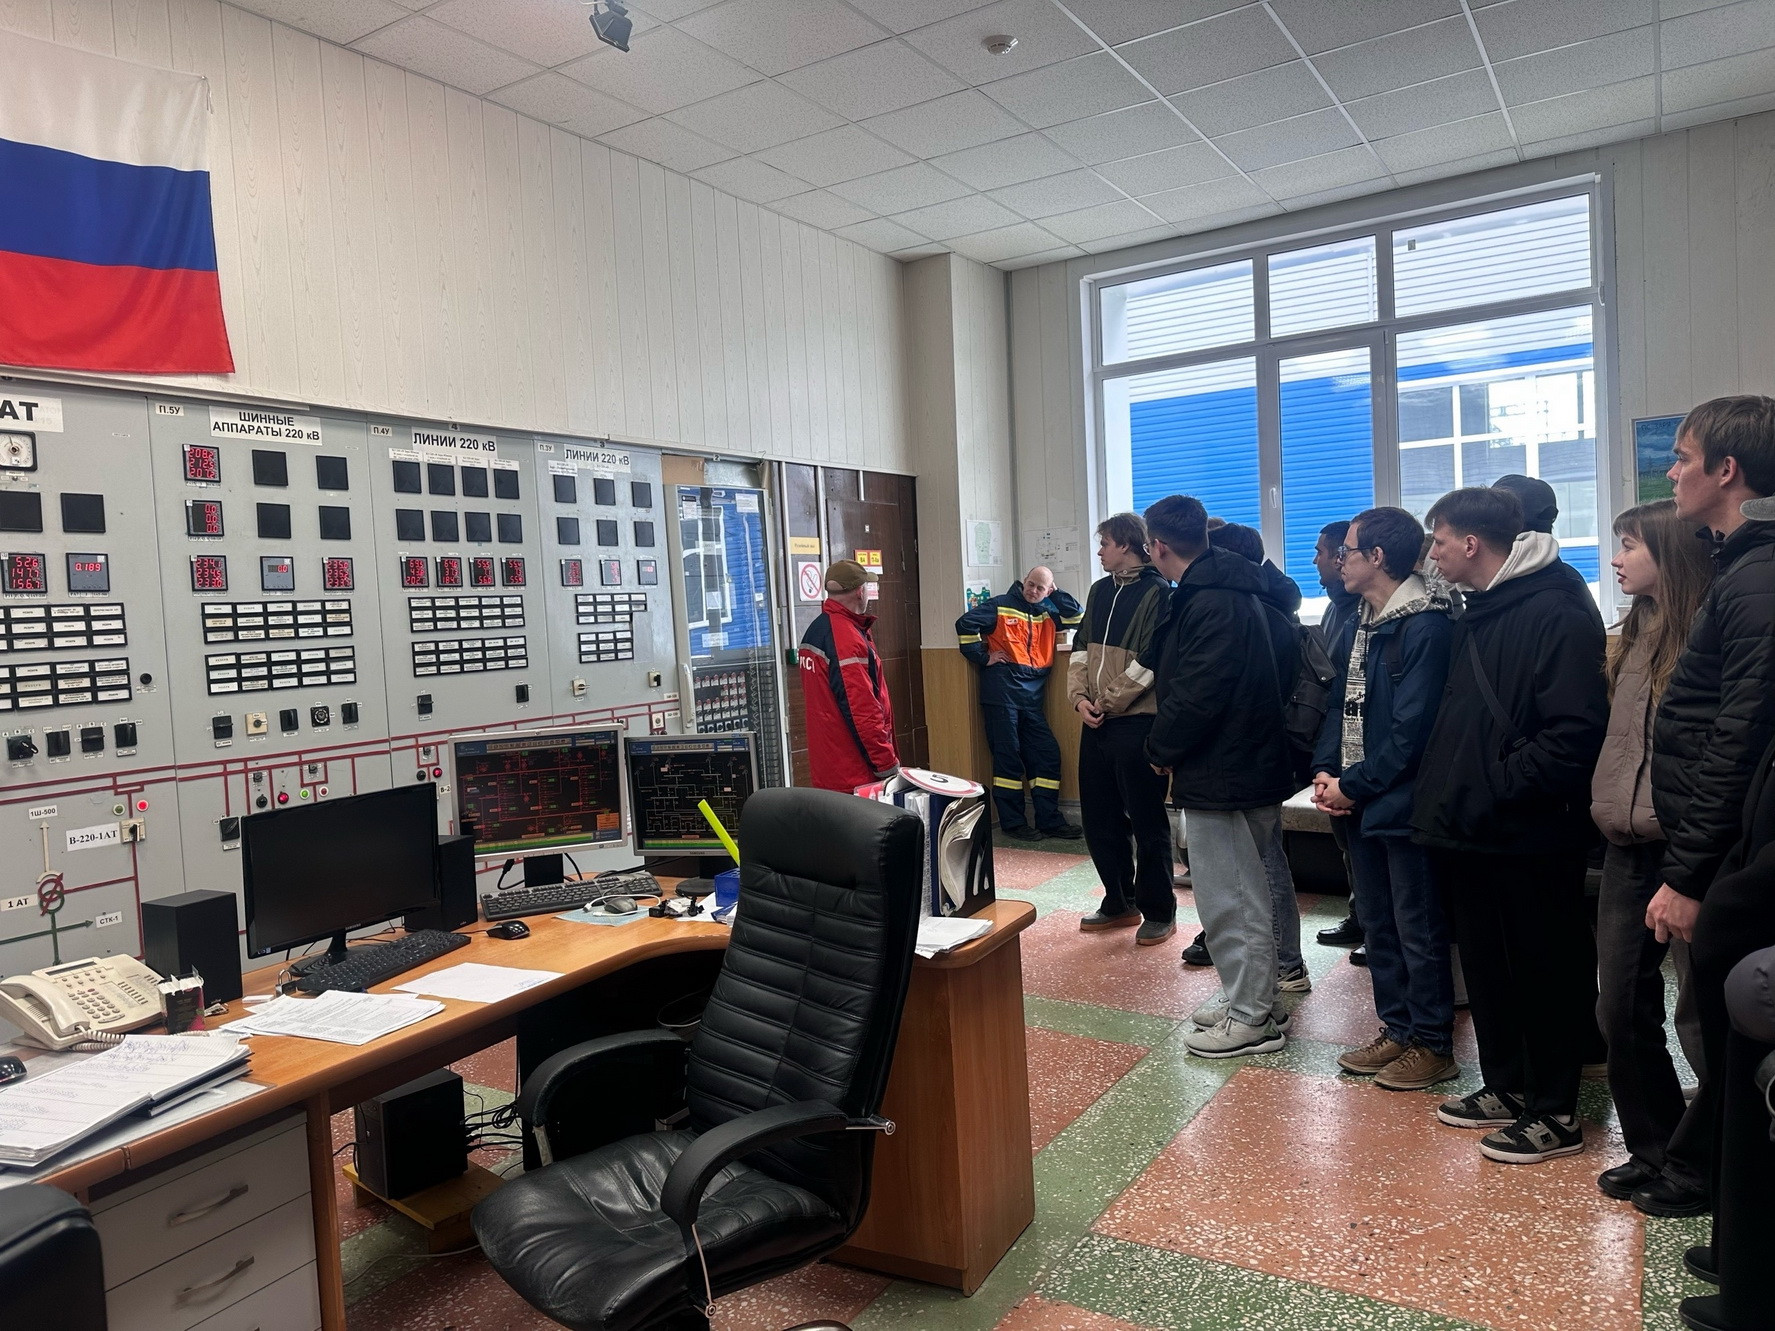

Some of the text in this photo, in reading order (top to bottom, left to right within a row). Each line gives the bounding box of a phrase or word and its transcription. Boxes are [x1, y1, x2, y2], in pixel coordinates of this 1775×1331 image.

[159, 405, 180, 415] П.5У
[239, 411, 295, 427] ШИННЫЕ
[212, 421, 320, 441] АППАРАТЫ 220 кВ
[373, 427, 390, 435] П.4У
[414, 432, 496, 452] ЛИНИИ 220 кВ
[565, 449, 630, 466] ЛИНИИ 220 кВ
[75, 562, 102, 572] 0.189
[30, 807, 56, 817] 1Ш-500
[69, 829, 118, 845] В-220-1АТ
[8, 897, 29, 909] 1 АТ
[99, 915, 119, 925] СТК-1
